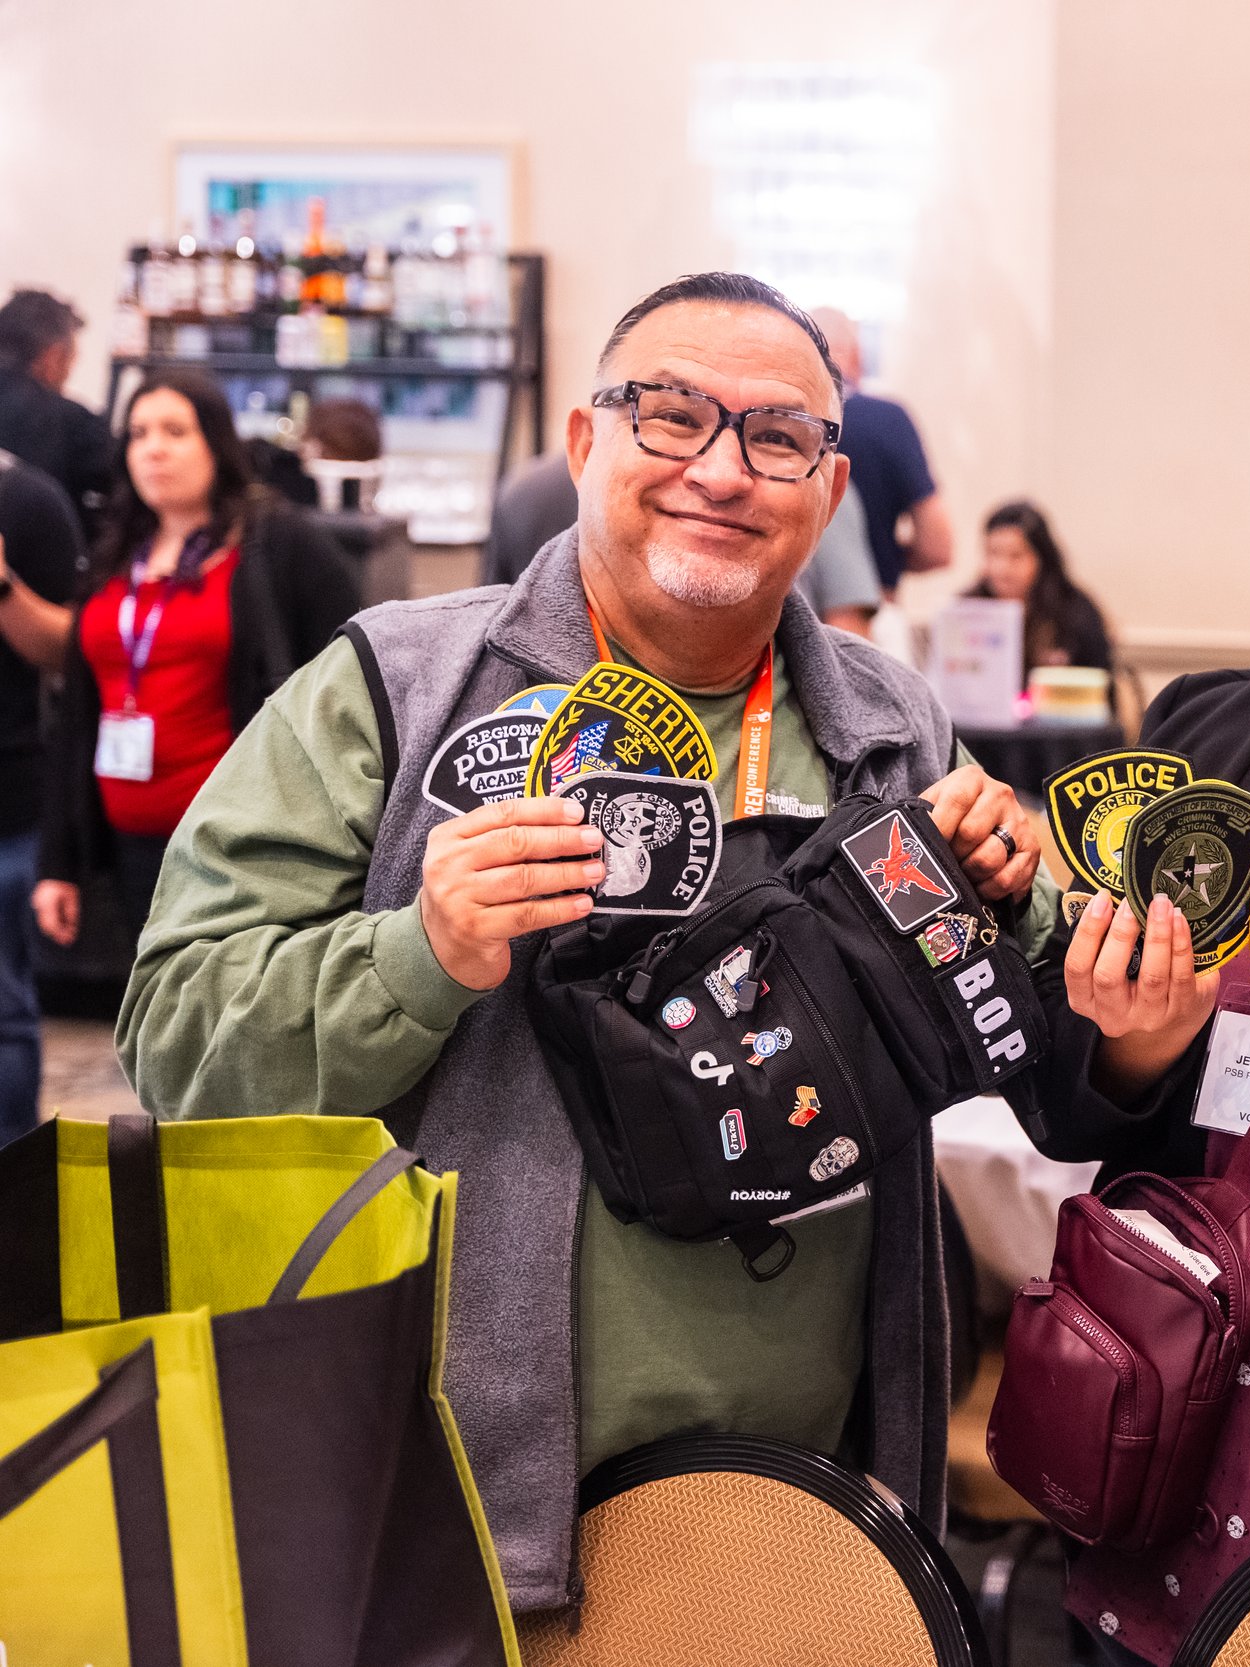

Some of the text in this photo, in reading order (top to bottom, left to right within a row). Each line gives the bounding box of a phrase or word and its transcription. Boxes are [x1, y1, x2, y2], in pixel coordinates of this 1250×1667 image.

[466, 724, 546, 750] REGIONA
[582, 671, 710, 780] SHERIFF
[641, 734, 659, 755] 1840
[746, 726, 762, 786] CONFERENCE
[454, 736, 539, 786] POLI
[475, 770, 526, 791] ACADE
[1064, 763, 1178, 809] POLICE
[603, 801, 618, 836] POLICE
[647, 794, 681, 822] GRAND
[1085, 792, 1144, 842] CRESCENT
[1146, 803, 1189, 833] DEPARTMENT
[1190, 803, 1200, 811] OF
[1177, 813, 1216, 826] CRIMINAL
[658, 809, 673, 838] OFFICER
[1164, 822, 1228, 846] INVESTIGATIONS
[671, 795, 710, 901] POLICE
[1194, 953, 1218, 964] SIANA
[705, 977, 733, 1017] CHAMPIONS
[953, 958, 1027, 1073] B.O.P.
[1224, 1066, 1244, 1078] PSB
[730, 1190, 791, 1201] #FORYOU
